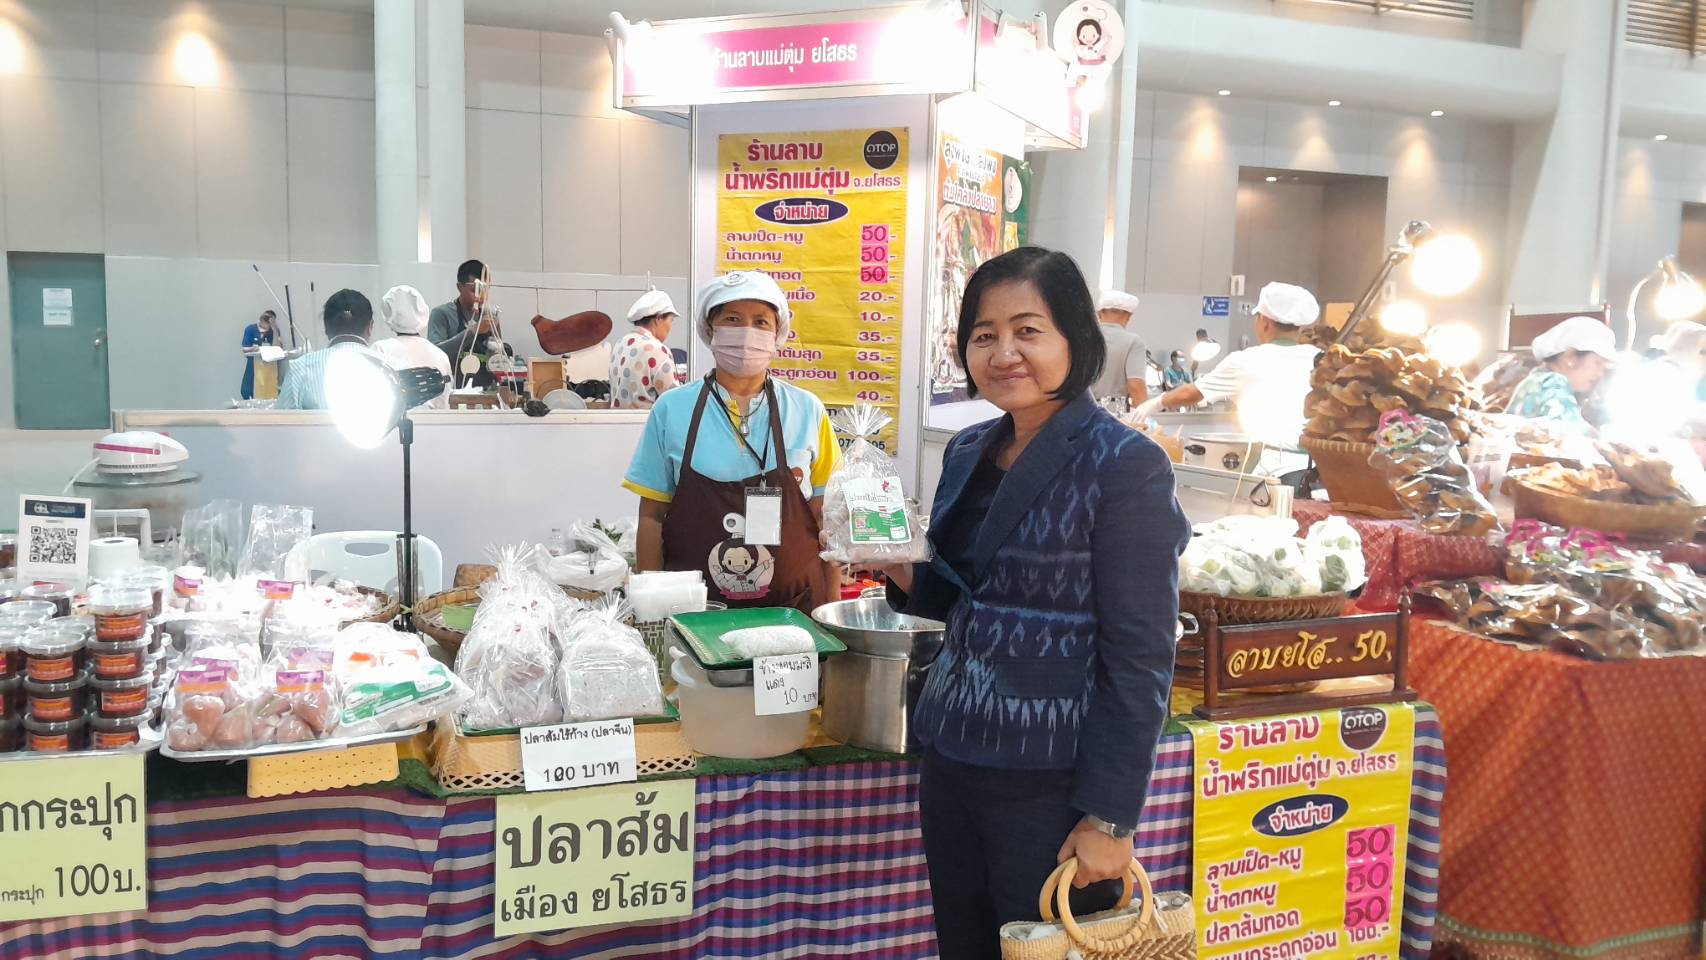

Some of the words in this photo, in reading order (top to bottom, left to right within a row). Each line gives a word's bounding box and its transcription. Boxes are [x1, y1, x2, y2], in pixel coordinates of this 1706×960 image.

[811, 37, 858, 65] ยโสธร
[748, 139, 823, 161] ร้านลาบ
[866, 143, 897, 153] OTOP
[725, 162, 850, 196] น้ำพริกแม่ตุ่ม
[853, 173, 901, 188] จ.ยโสธร
[775, 202, 829, 220] จำหน่าย
[726, 229, 804, 245] ลาบเป็ด-หมู
[726, 246, 782, 264] น้ำตกหมู
[860, 291, 896, 302] 20.-
[860, 311, 895, 322] 10.-
[858, 331, 894, 343] 35.-
[857, 351, 893, 363] 35.-
[848, 370, 893, 382] 100.-
[856, 390, 892, 402] 40.-
[784, 687, 799, 706] 10
[1344, 711, 1384, 730] OTOP
[591, 723, 633, 743] (ปลาจีน)
[1219, 715, 1320, 751] รานลาบ
[582, 760, 620, 780] บาท
[1203, 754, 1331, 798] น้ำพริกแม่ตุ่ม
[1335, 752, 1397, 776] จ.ยโสธร
[1269, 802, 1333, 829] จำหน่าย
[502, 790, 689, 869] ปลาส้ม
[1206, 848, 1302, 881] ลาบเป็ด-หมู
[501, 884, 578, 923] เมือง
[592, 872, 688, 913] ยโสธร
[1206, 884, 1277, 913] น้ำตกหมู
[1205, 910, 1300, 944] ปลาส้มทอด
